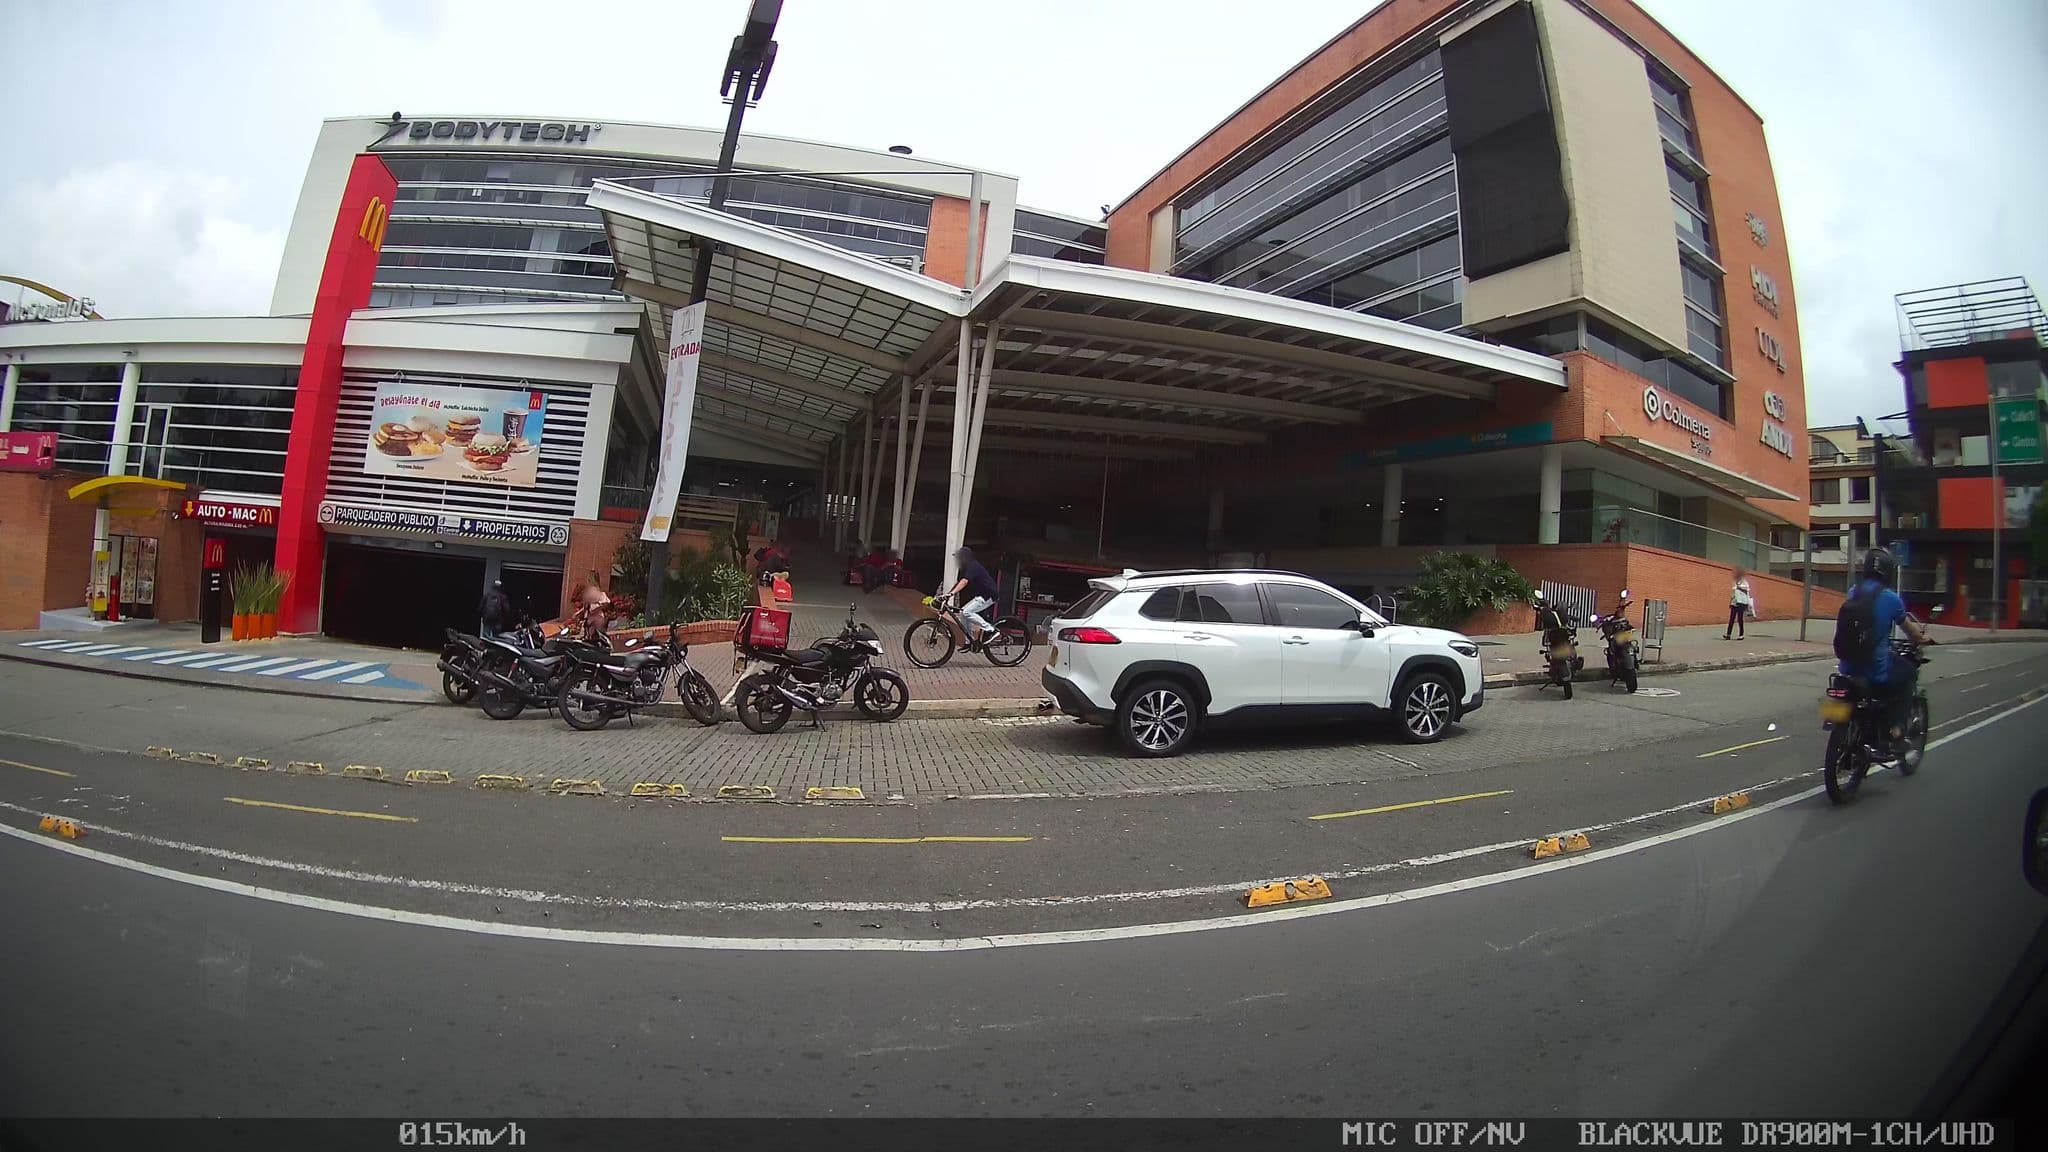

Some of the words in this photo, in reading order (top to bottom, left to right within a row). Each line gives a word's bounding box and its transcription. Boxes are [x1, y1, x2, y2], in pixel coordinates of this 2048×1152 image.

[409, 121, 591, 143] BODYTECH
[1749, 263, 1778, 306] HDI
[1663, 401, 1711, 441] Colmena
[1759, 418, 1792, 459] ANDI
[197, 505, 226, 518] AUTO
[232, 507, 257, 520] MAC
[336, 508, 397, 523] PARQUEADERO
[398, 512, 435, 527] PUBLICO
[476, 521, 545, 537] PROPIETARIOS
